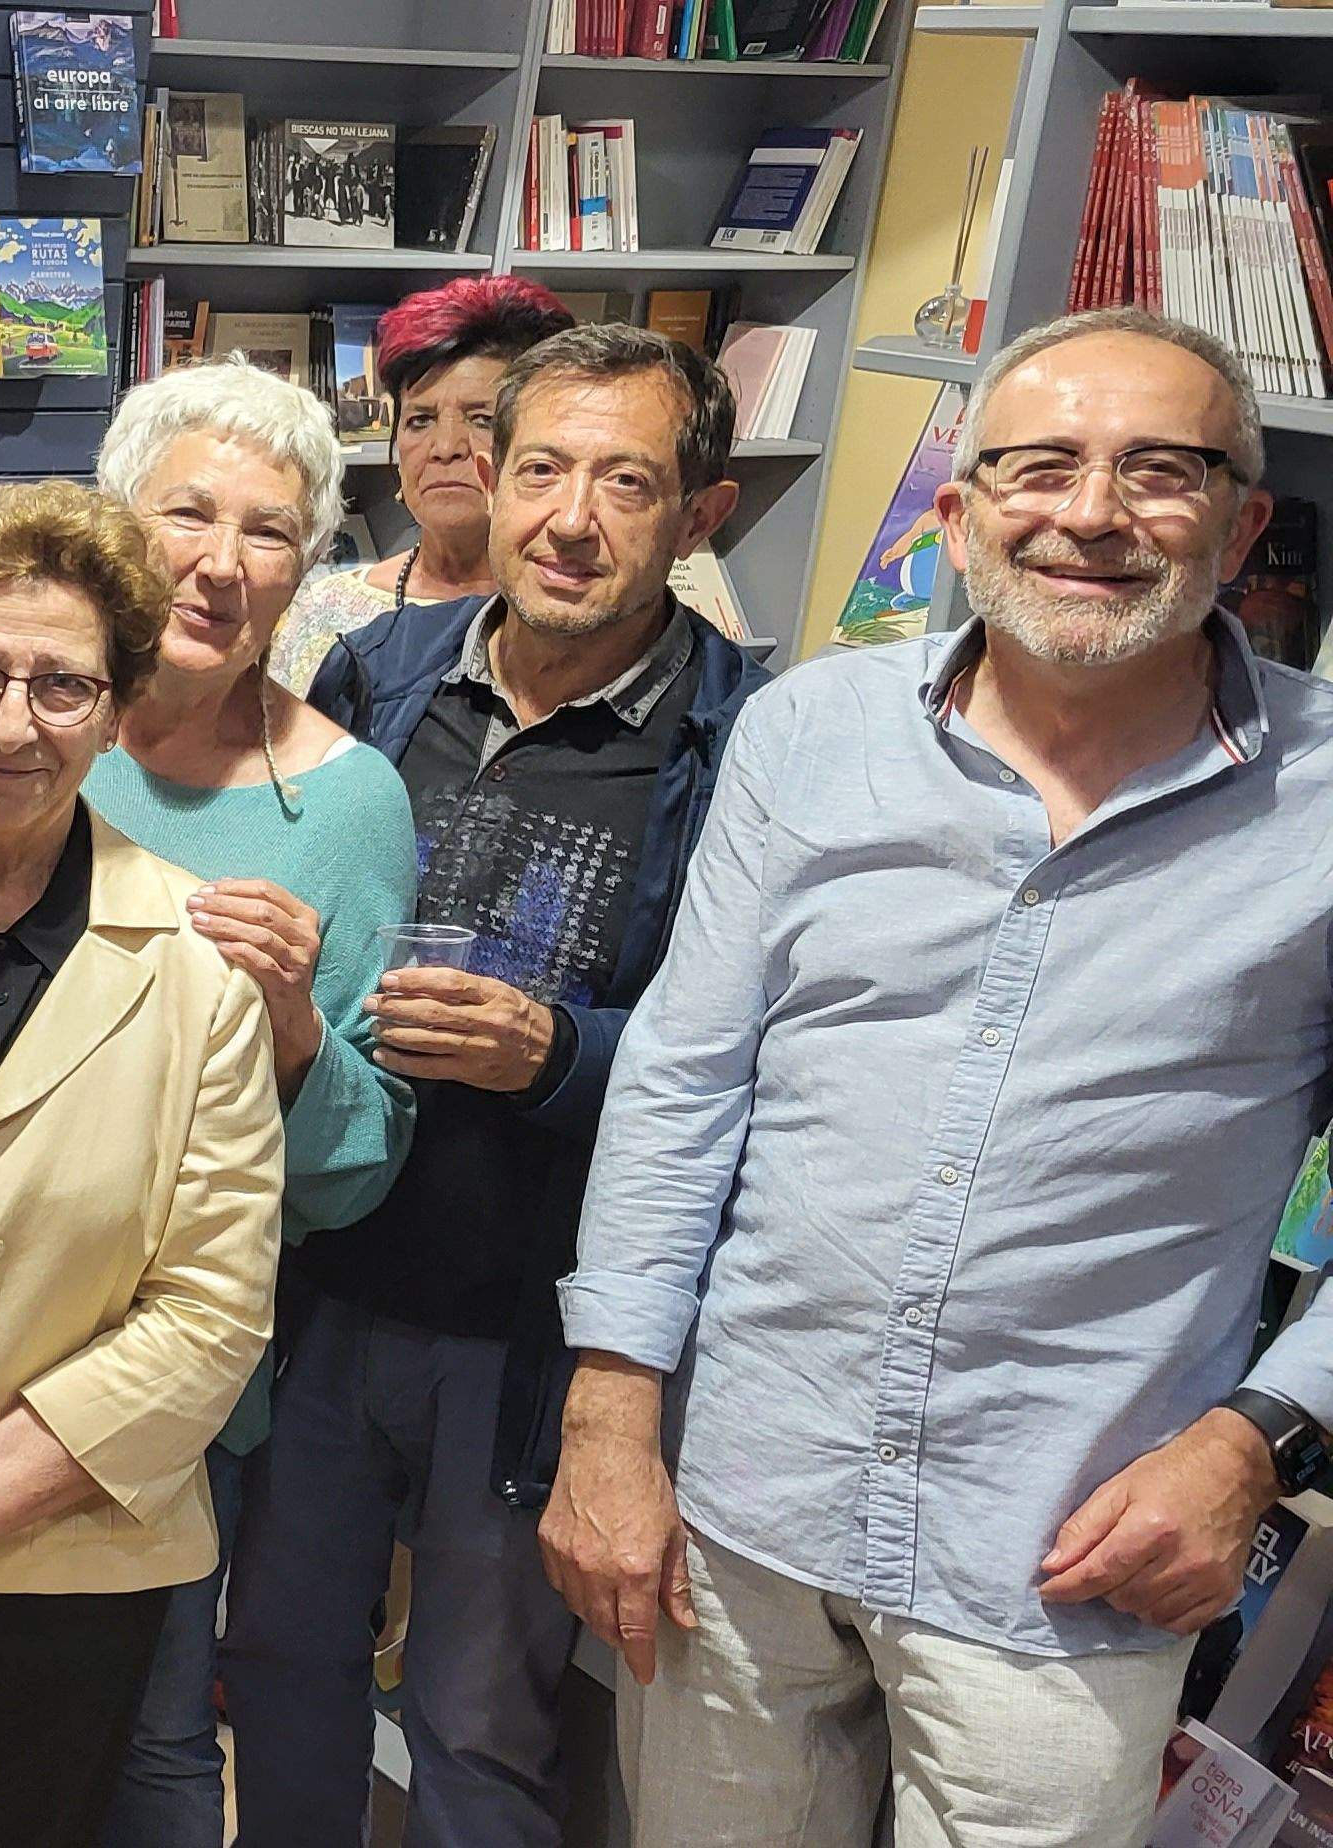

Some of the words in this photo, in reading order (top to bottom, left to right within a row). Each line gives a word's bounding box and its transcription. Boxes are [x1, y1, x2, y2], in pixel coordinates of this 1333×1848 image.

[46, 69, 111, 88] europa
[33, 93, 49, 110] al
[54, 95, 90, 111] aire
[91, 95, 129, 113] libre
[291, 124, 324, 136] BIESCAS
[325, 126, 338, 136] NO
[339, 126, 356, 137] TAN
[357, 127, 389, 138] LEJANA
[31, 249, 68, 259] RUTAS
[1268, 541, 1302, 565] Kim
[1288, 1808, 1308, 1828] UN
